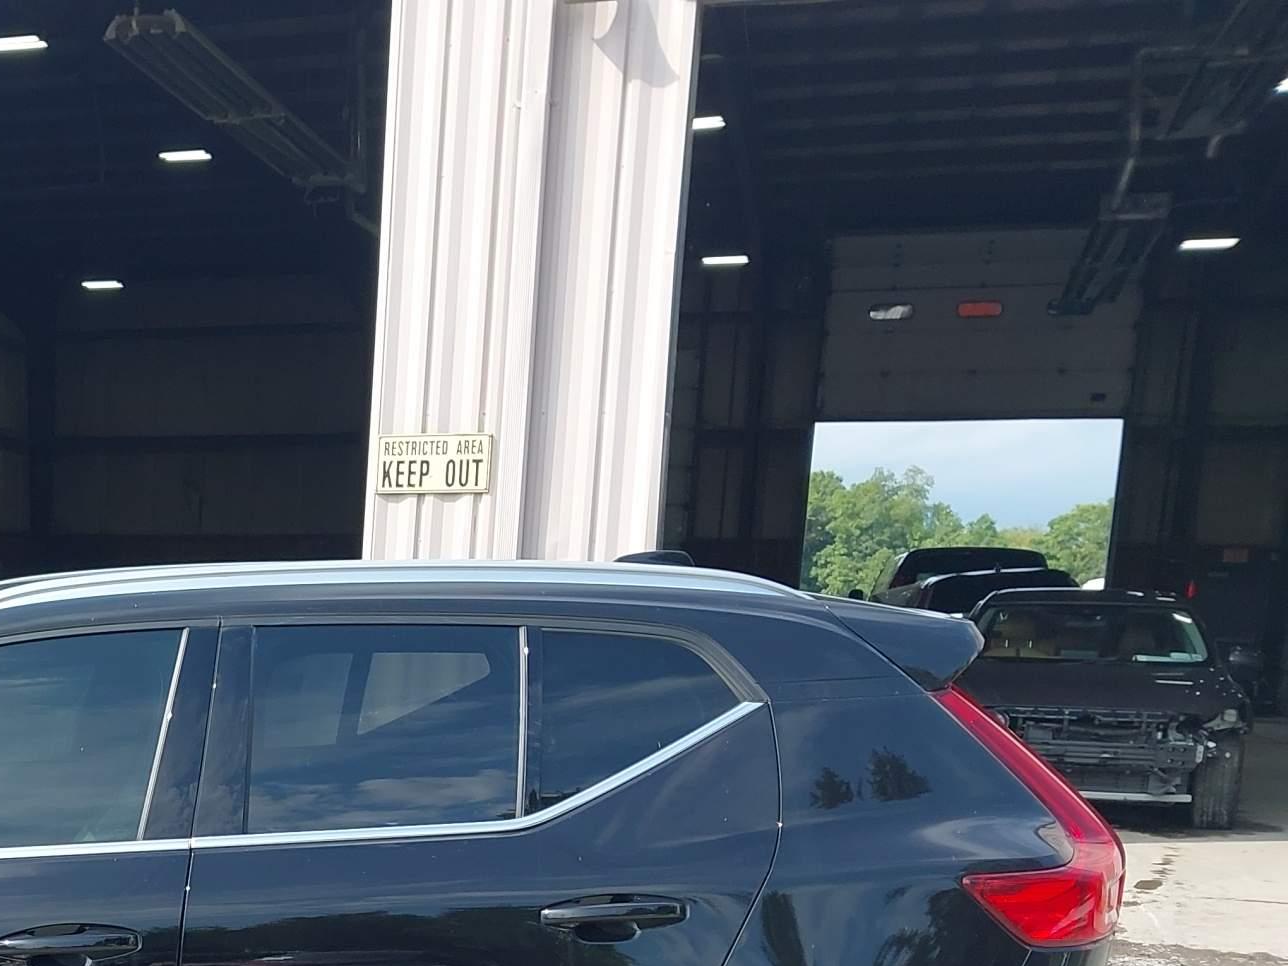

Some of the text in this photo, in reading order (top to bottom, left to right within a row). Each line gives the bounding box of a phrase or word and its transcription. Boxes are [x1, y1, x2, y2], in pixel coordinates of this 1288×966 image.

[384, 439, 484, 456] RESTRICTED AREA
[381, 459, 484, 488] KEEP OUT
